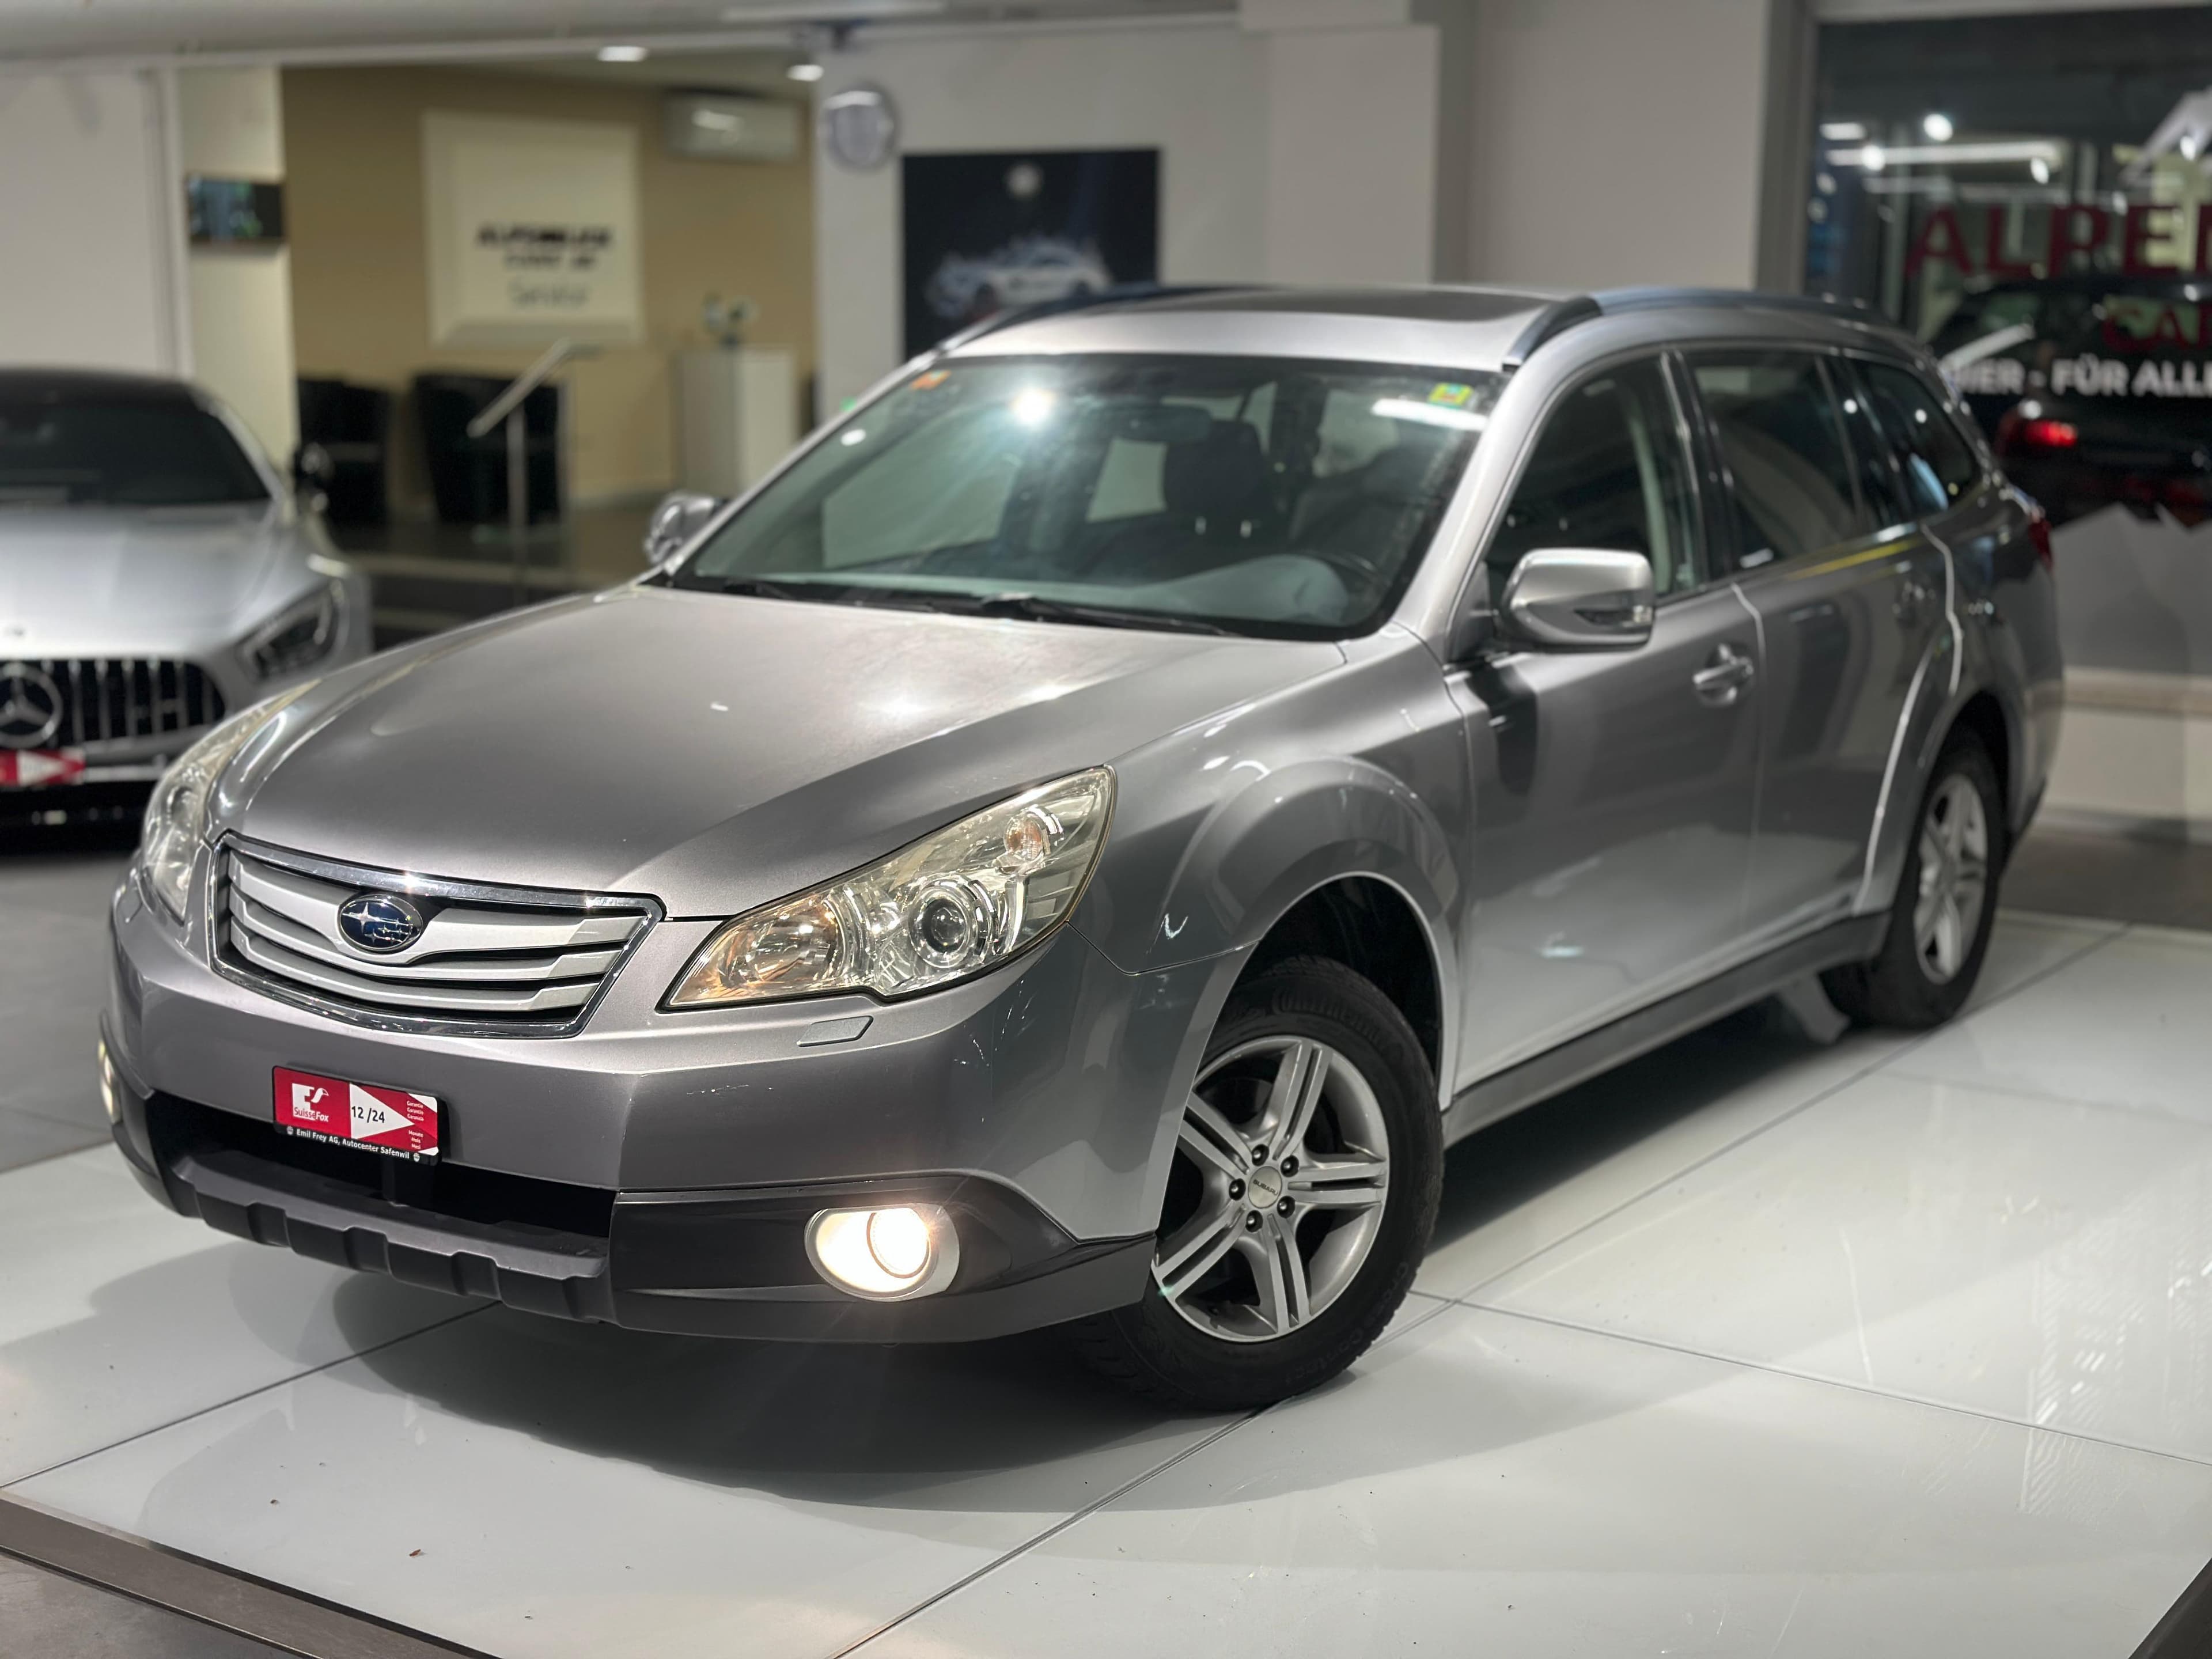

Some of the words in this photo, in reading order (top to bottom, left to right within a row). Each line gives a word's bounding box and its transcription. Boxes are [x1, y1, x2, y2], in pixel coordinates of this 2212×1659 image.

[1904, 203, 2212, 279] ALPE
[2051, 352, 2130, 396] FÜR
[294, 1107, 329, 1123] SuisseFox
[351, 1105, 364, 1119] 12
[366, 1109, 385, 1123] /24
[297, 1128, 311, 1138] Emil
[312, 1132, 327, 1143] Frey
[329, 1135, 340, 1146] AG,
[342, 1138, 379, 1152] Autocenter
[380, 1146, 410, 1160] Safenwil
[1253, 1179, 1279, 1196] SUBARU
